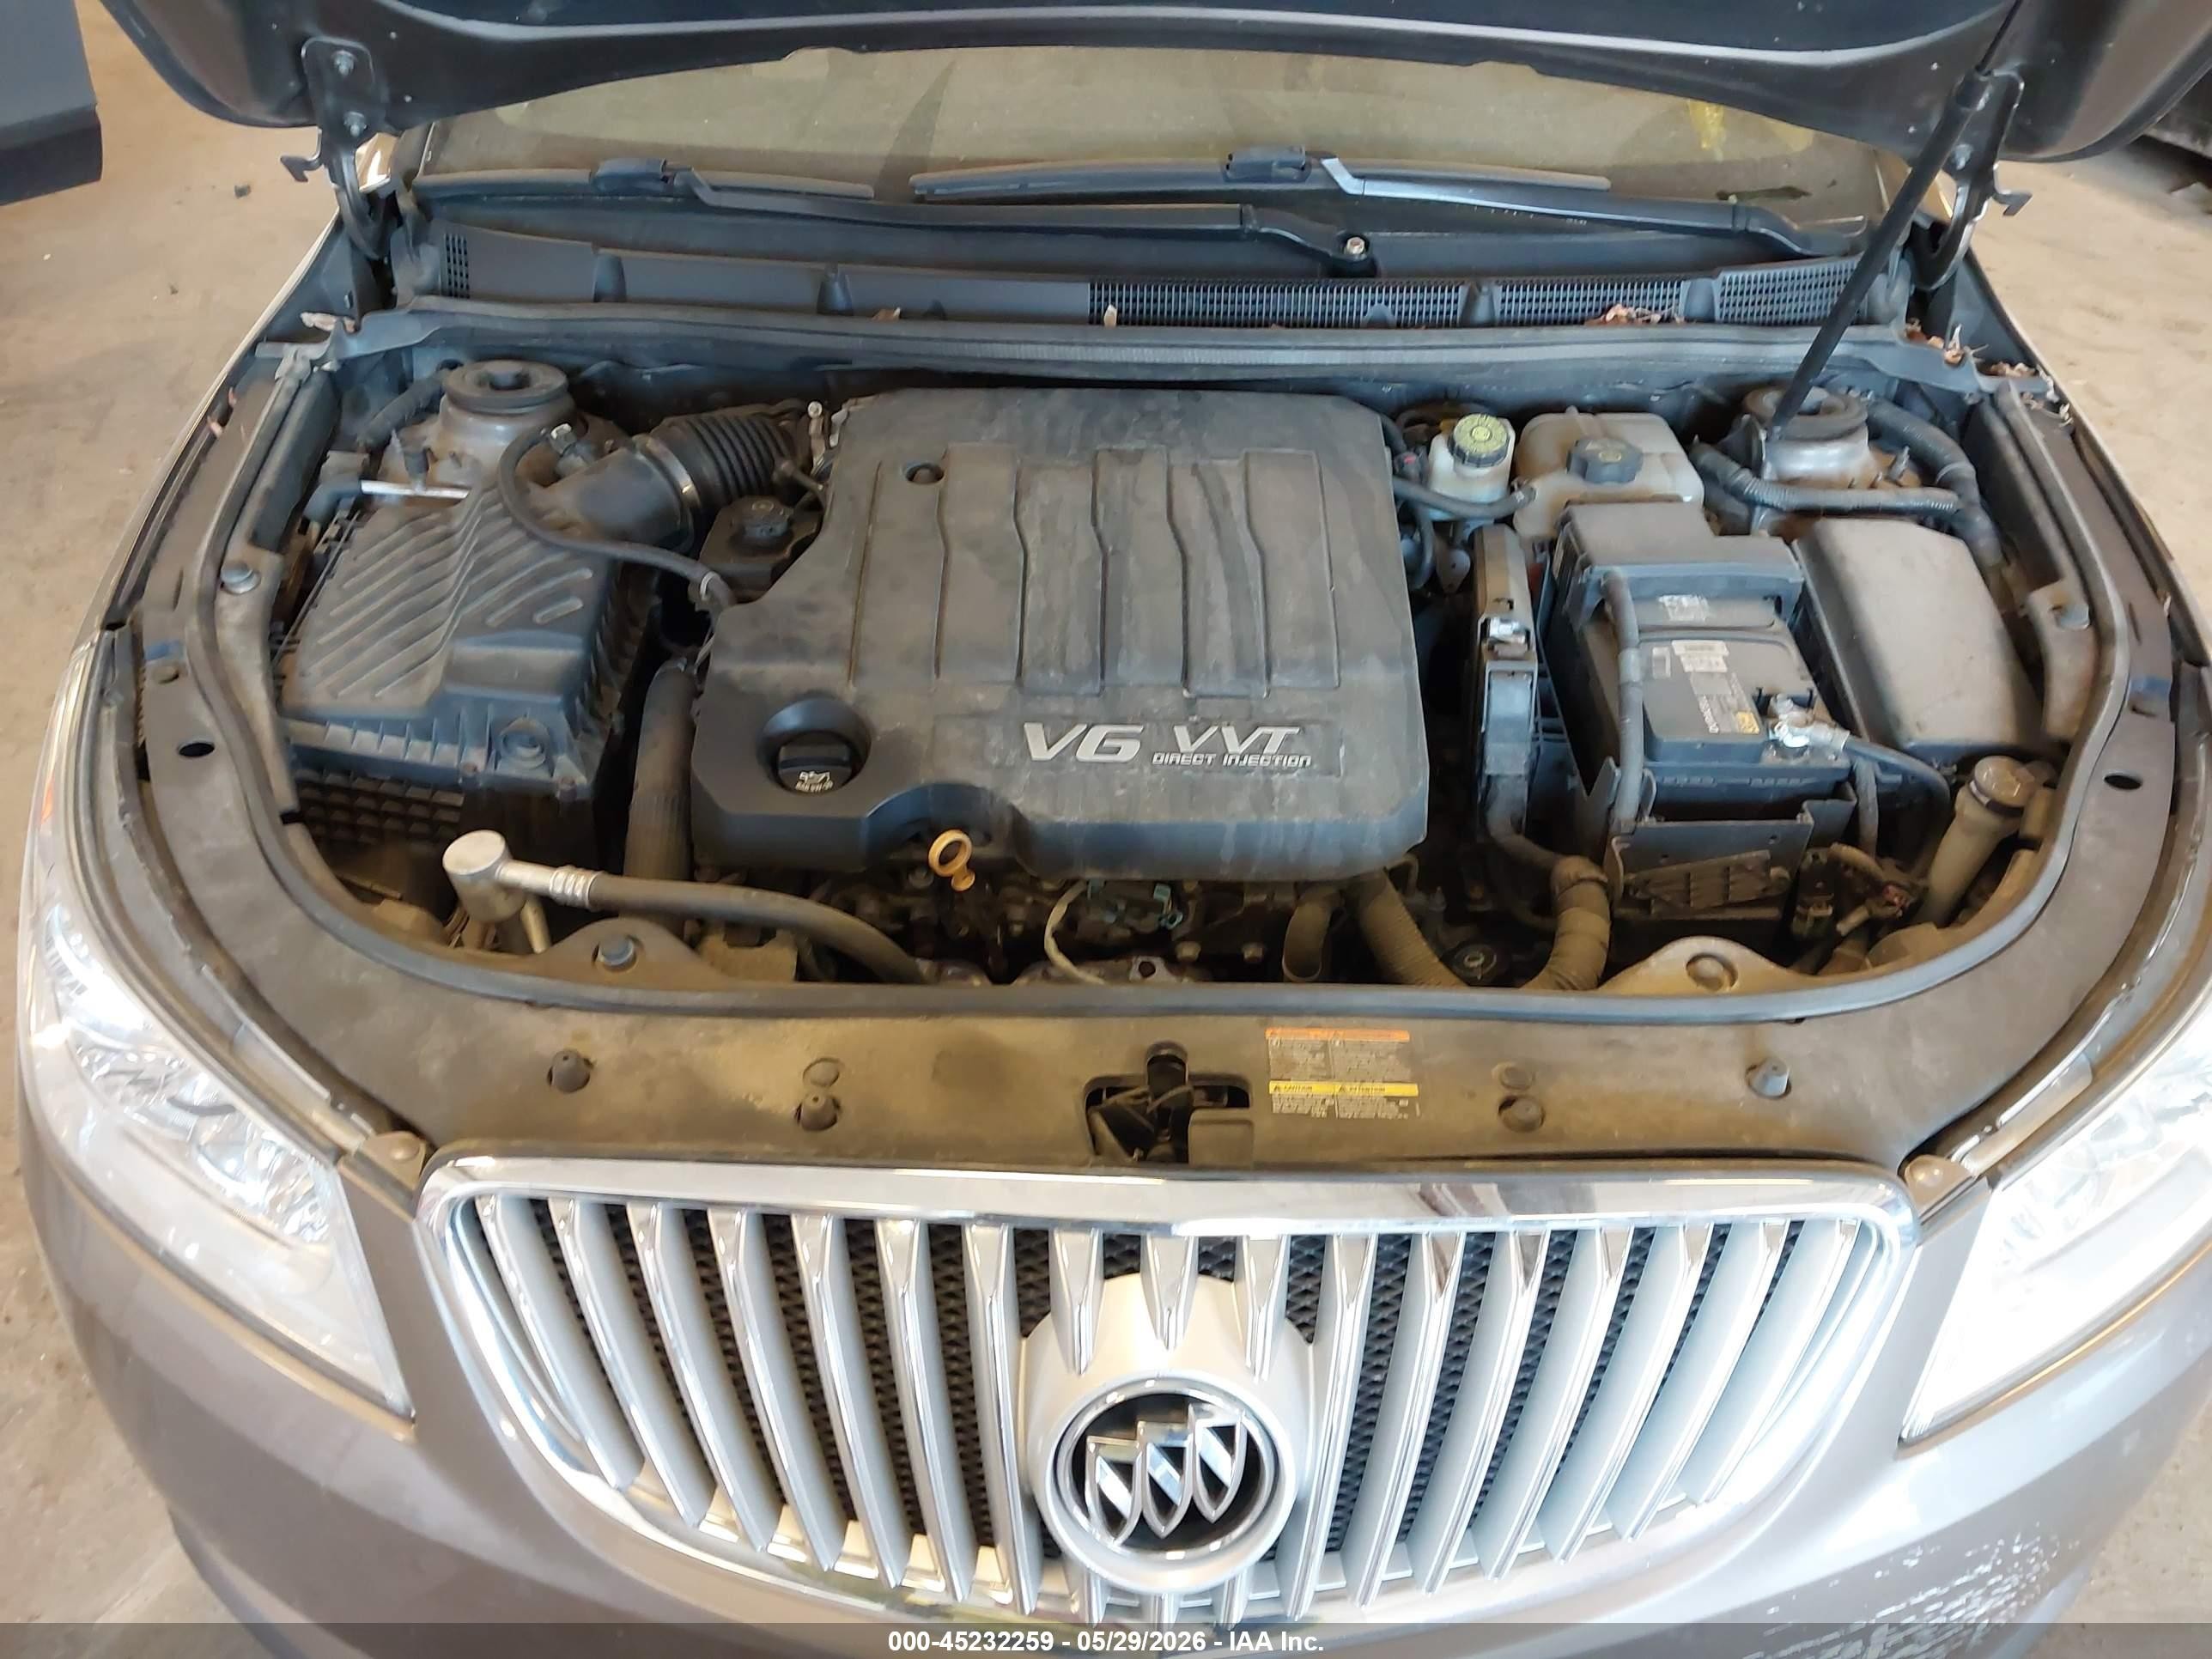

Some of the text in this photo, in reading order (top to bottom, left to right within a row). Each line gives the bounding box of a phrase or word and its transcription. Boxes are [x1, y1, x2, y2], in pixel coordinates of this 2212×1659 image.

[1024, 722, 1300, 763] V6 VVT
[1152, 752, 1312, 768] DIRECT INJECTION
